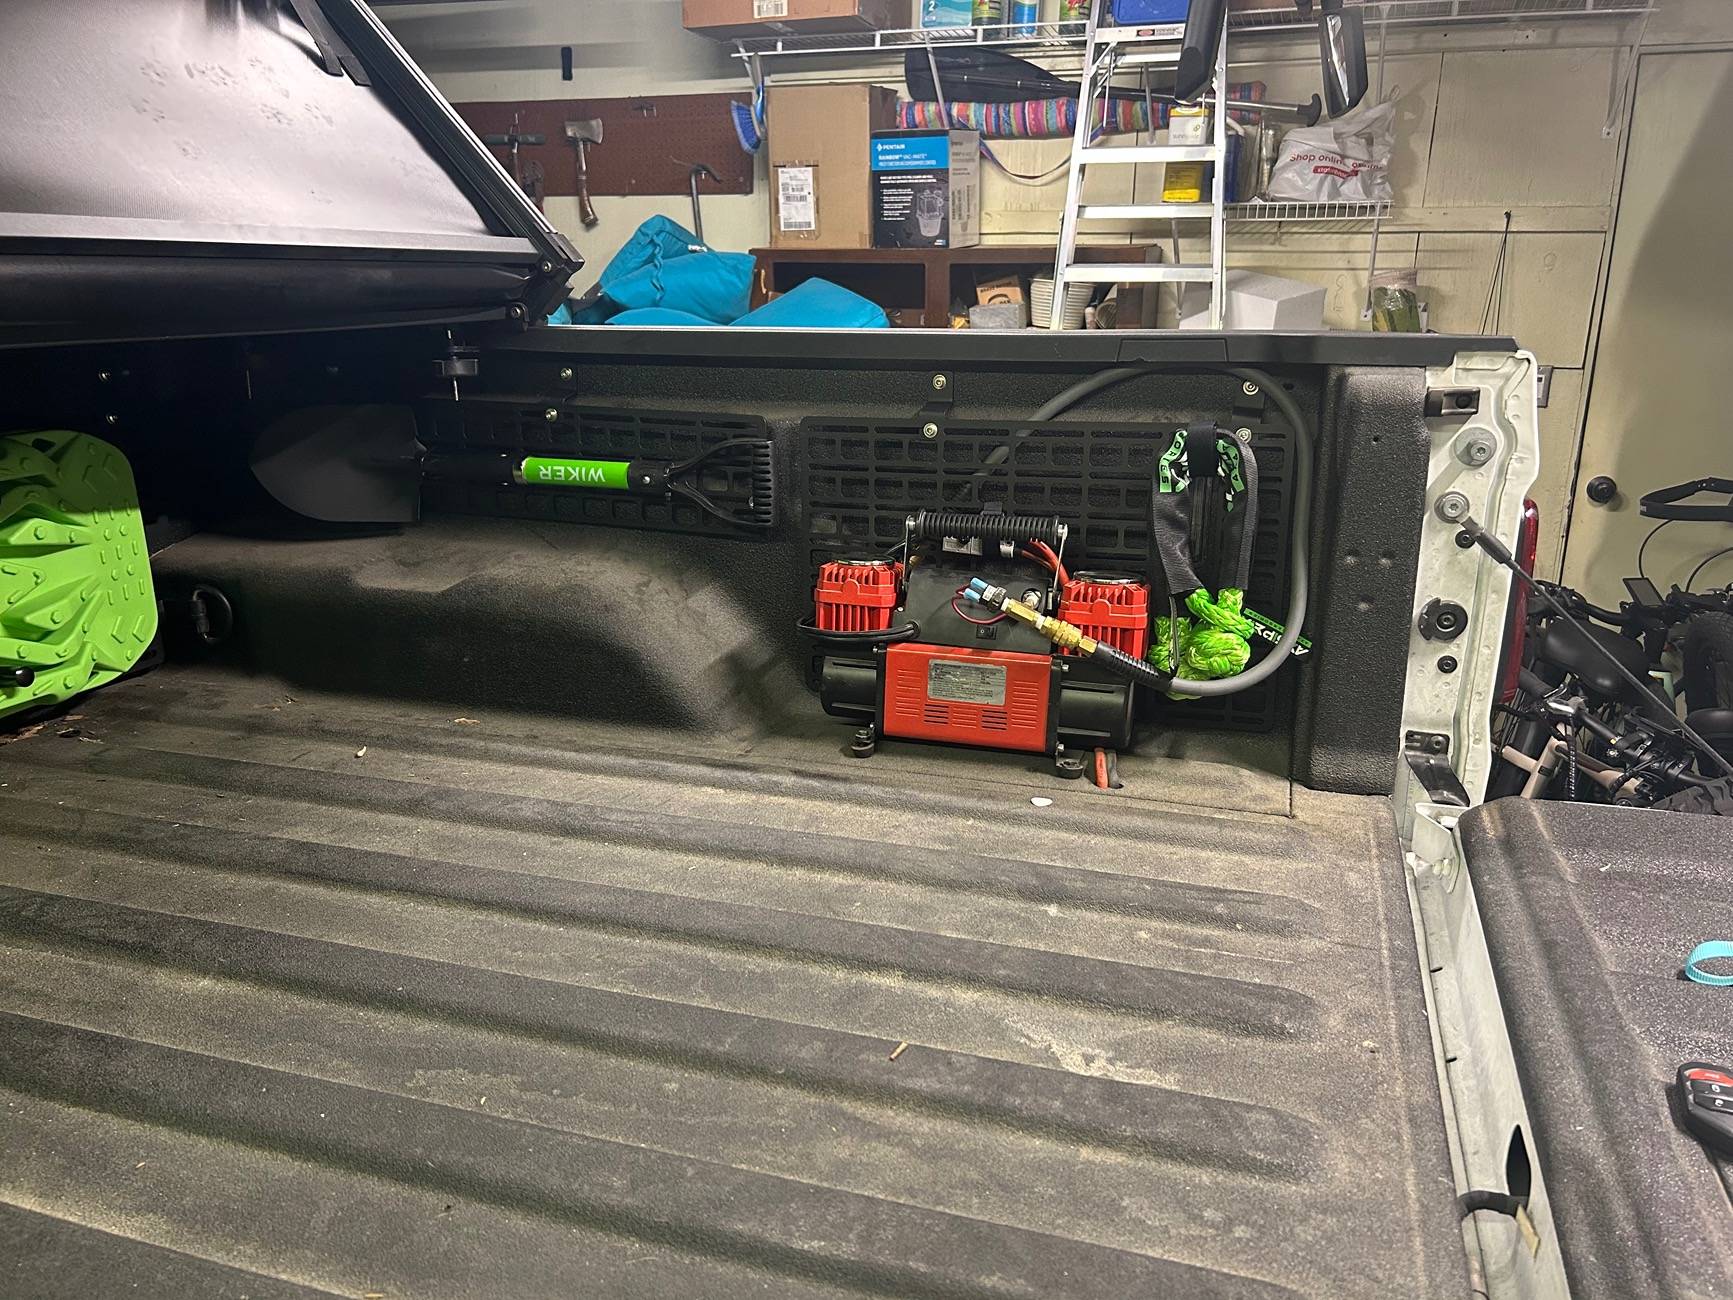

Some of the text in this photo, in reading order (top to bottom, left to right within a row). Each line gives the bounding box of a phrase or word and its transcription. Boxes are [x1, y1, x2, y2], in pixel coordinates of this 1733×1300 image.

[928, 0, 935, 11] 2
[1290, 153, 1316, 163] Shop
[1318, 154, 1344, 165] onlin
[538, 465, 606, 482] WIKER
